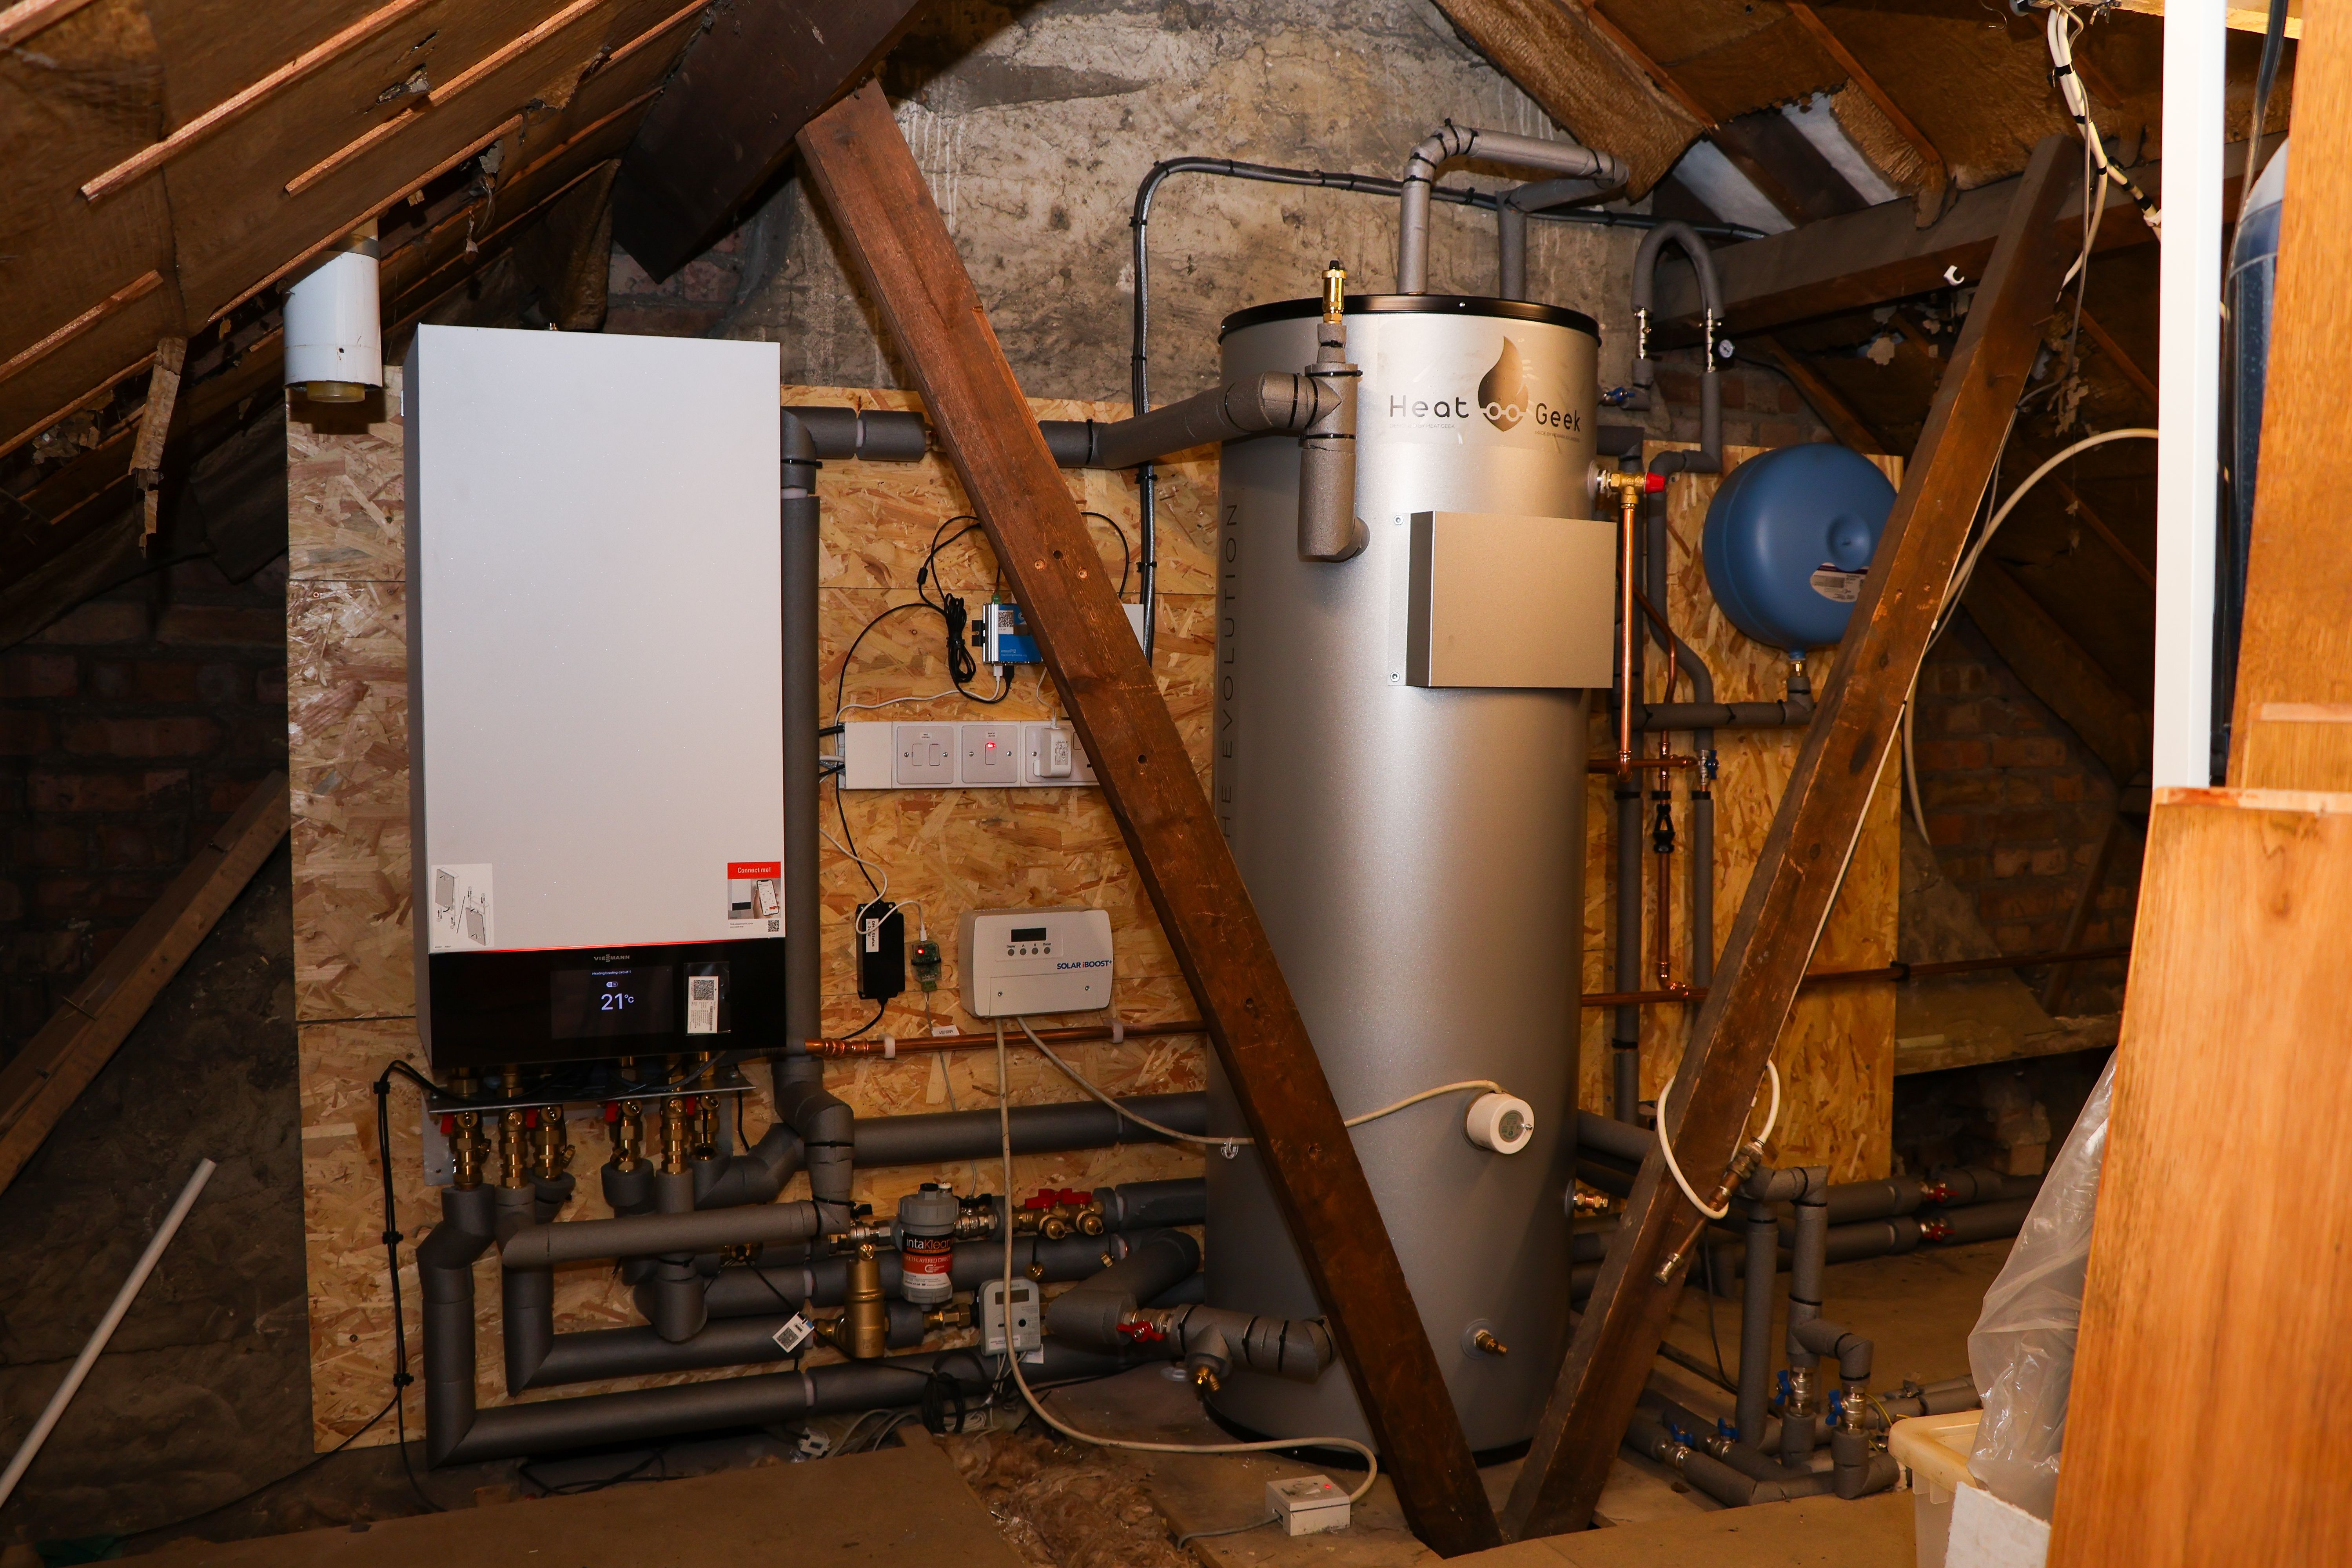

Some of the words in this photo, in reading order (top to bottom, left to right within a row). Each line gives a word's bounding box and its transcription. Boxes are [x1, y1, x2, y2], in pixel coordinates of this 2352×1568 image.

[1390, 395, 1469, 418] Heat
[1536, 403, 1580, 432] Geek
[1223, 504, 1237, 758] EVOLUTION
[1221, 786, 1231, 838] HE
[593, 954, 630, 962] VIESSMANN
[906, 1236, 951, 1249] intaKlean
